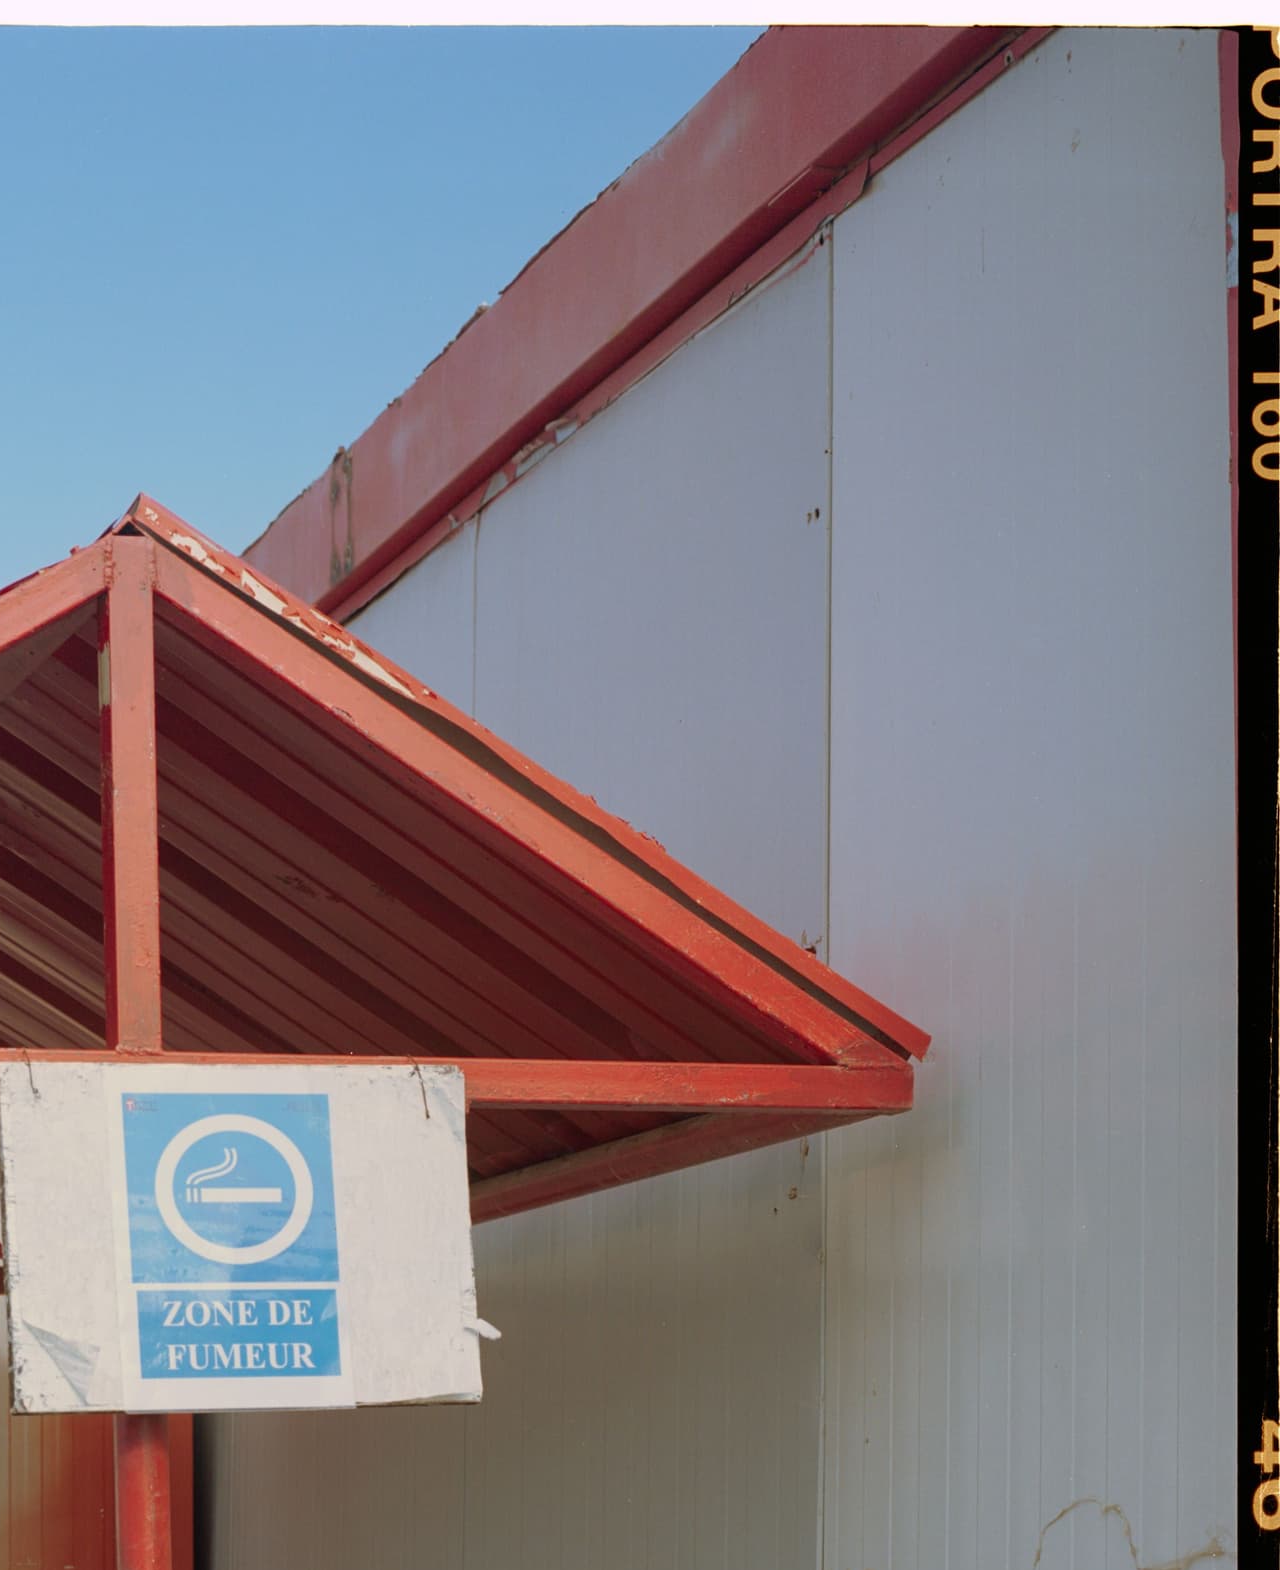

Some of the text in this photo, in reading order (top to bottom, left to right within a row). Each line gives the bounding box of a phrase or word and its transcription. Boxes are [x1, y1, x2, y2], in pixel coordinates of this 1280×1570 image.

[161, 1299, 314, 1328] ZONE DE
[166, 1342, 317, 1371] FUMEUR
